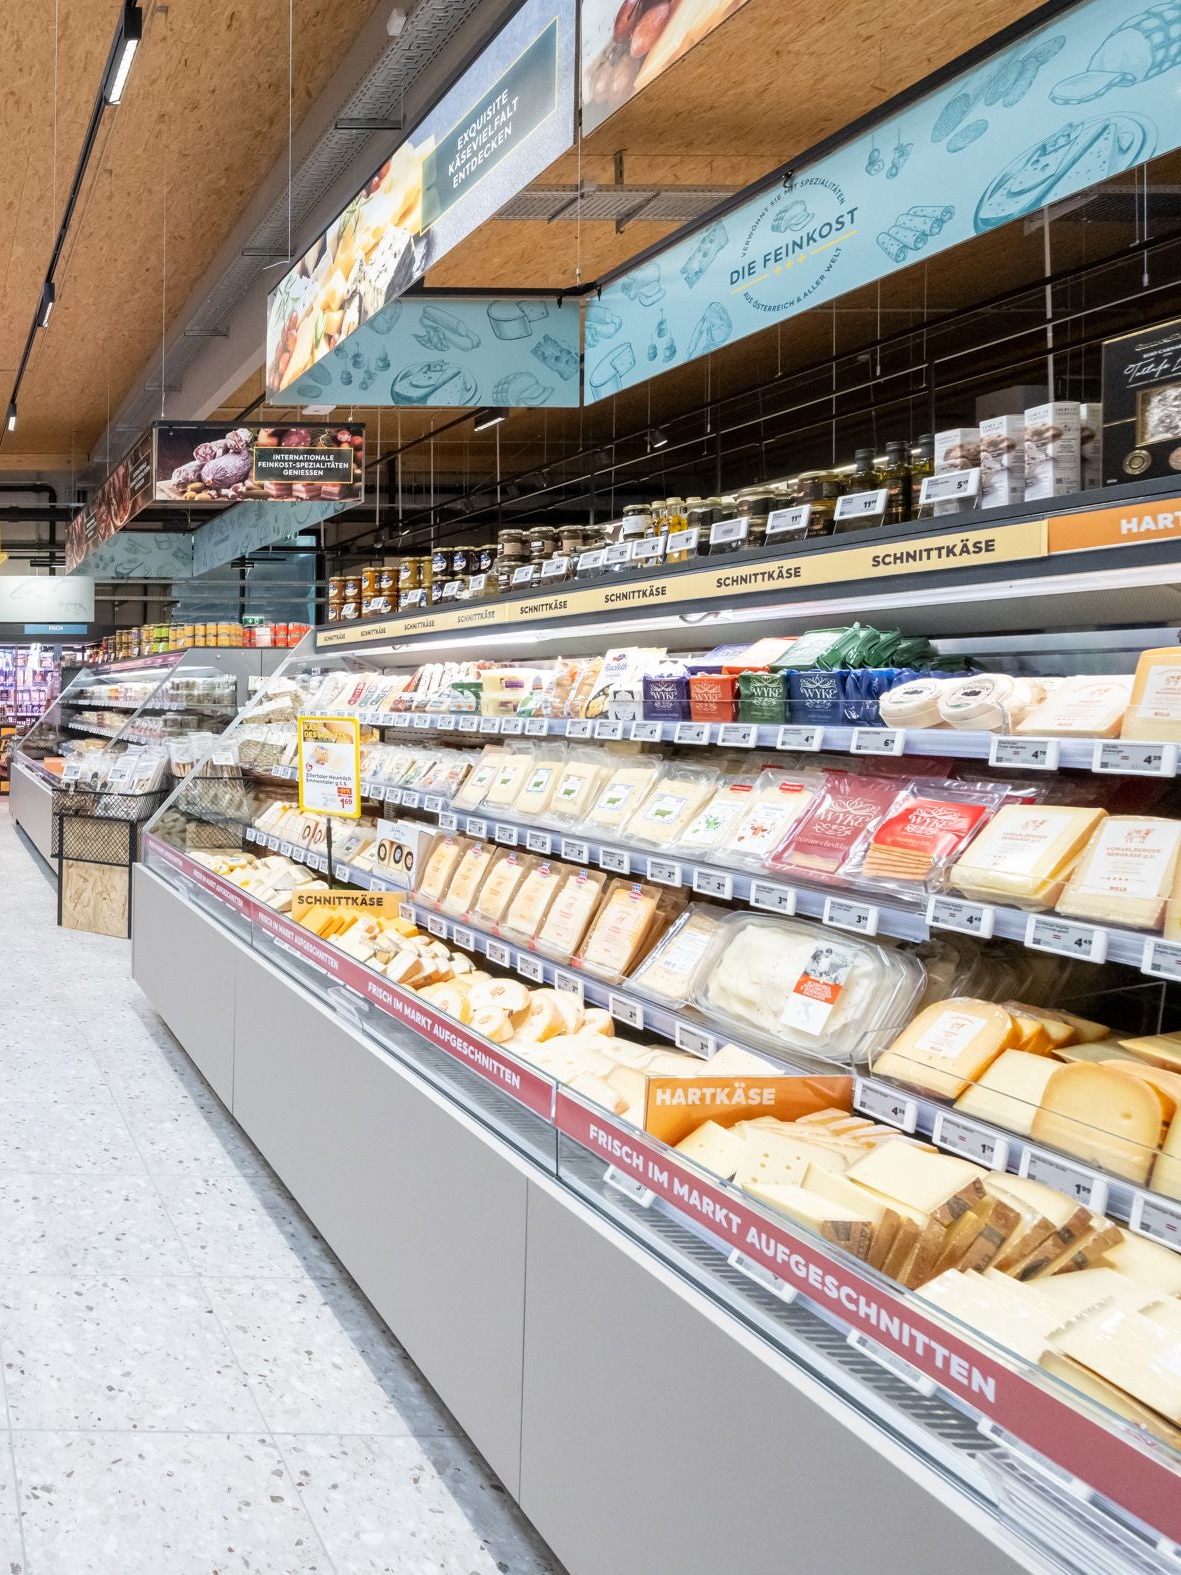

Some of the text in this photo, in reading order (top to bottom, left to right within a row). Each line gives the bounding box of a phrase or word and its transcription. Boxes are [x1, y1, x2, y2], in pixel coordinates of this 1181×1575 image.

[457, 89, 509, 150] EXQUISITE
[448, 96, 519, 177] KÄSEVIELFALT
[452, 122, 513, 189] ENTDECKEN
[770, 193, 782, 207] SIE
[799, 177, 847, 206] SPEZIALITÄTEN
[729, 206, 859, 286] DIE FEINKOST
[743, 291, 754, 304] AUS
[752, 300, 795, 312] ÖSTERREICH
[803, 274, 826, 298] ALLER
[824, 246, 842, 273] WELT
[258, 461, 349, 469] FEINKOST-SPEZIALITÄTEN
[871, 538, 996, 568] SCHNITTKÄSE
[716, 566, 802, 588] SCHNITTKÄSE
[604, 586, 667, 603] SCHNITTKÄSE
[457, 609, 496, 623] SCHNITTKÄSE
[519, 600, 568, 614] SCHNITTKÄSE
[360, 627, 386, 637] SCHNITTKÄSE
[404, 620, 435, 631] SCHNITTKÄSE
[651, 690, 677, 700] WYKE
[692, 692, 722, 701] WYKE
[752, 687, 783, 698] WYKE
[802, 687, 837, 699] WYKE
[818, 809, 871, 828] WYKE
[297, 894, 384, 906] SCHNITTKÄSE
[259, 912, 273, 927] FRISCH
[279, 924, 295, 942] MARKT
[294, 933, 339, 970] AUFGESCHNITTEN
[368, 982, 521, 1090] FRISCH IM MARKT AUFGESCHNITTEN
[655, 1081, 776, 1106] HARTKÄSE
[589, 1123, 997, 1404] FRISCH IM MARKT AUFGESCHNITTEN
